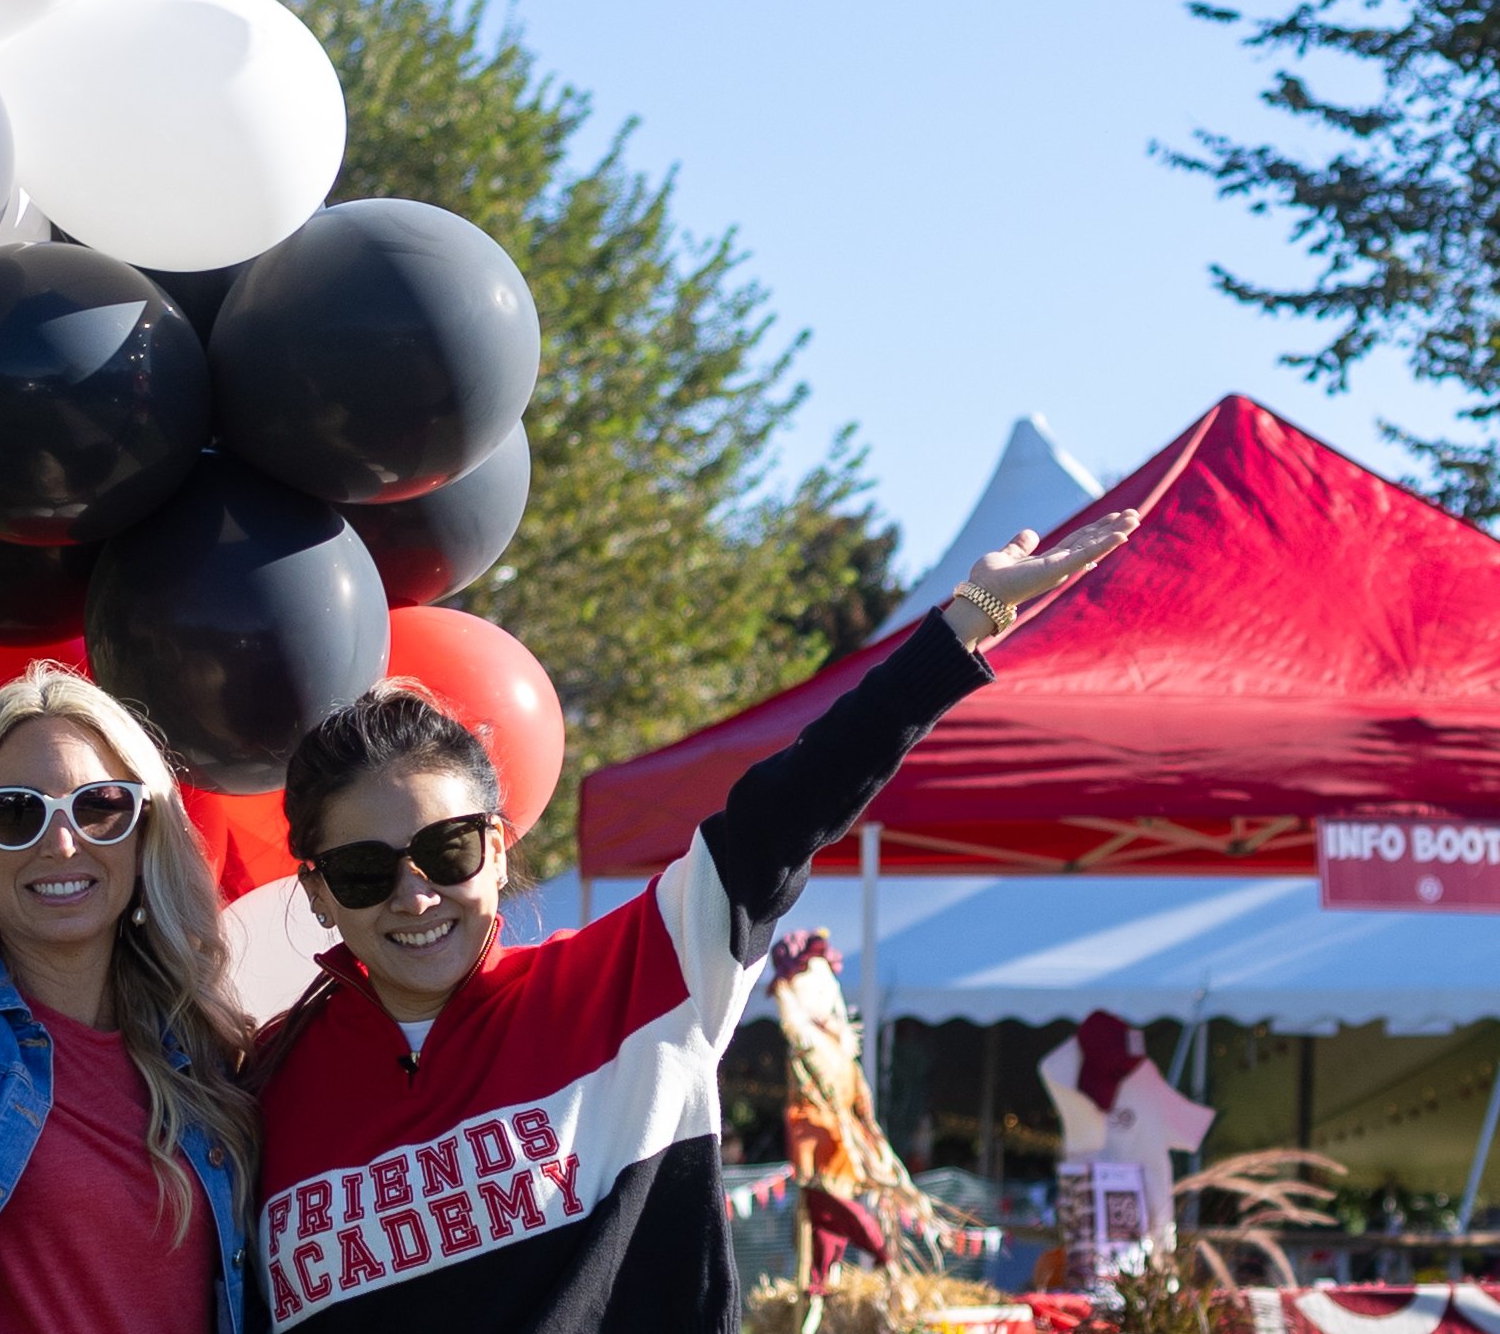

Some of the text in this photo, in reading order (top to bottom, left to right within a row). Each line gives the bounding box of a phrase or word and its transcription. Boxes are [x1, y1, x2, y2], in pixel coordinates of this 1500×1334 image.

[1326, 822, 1406, 862] INFO
[267, 1107, 560, 1258] FRIENDS
[268, 1153, 584, 1322] ACADEMY
